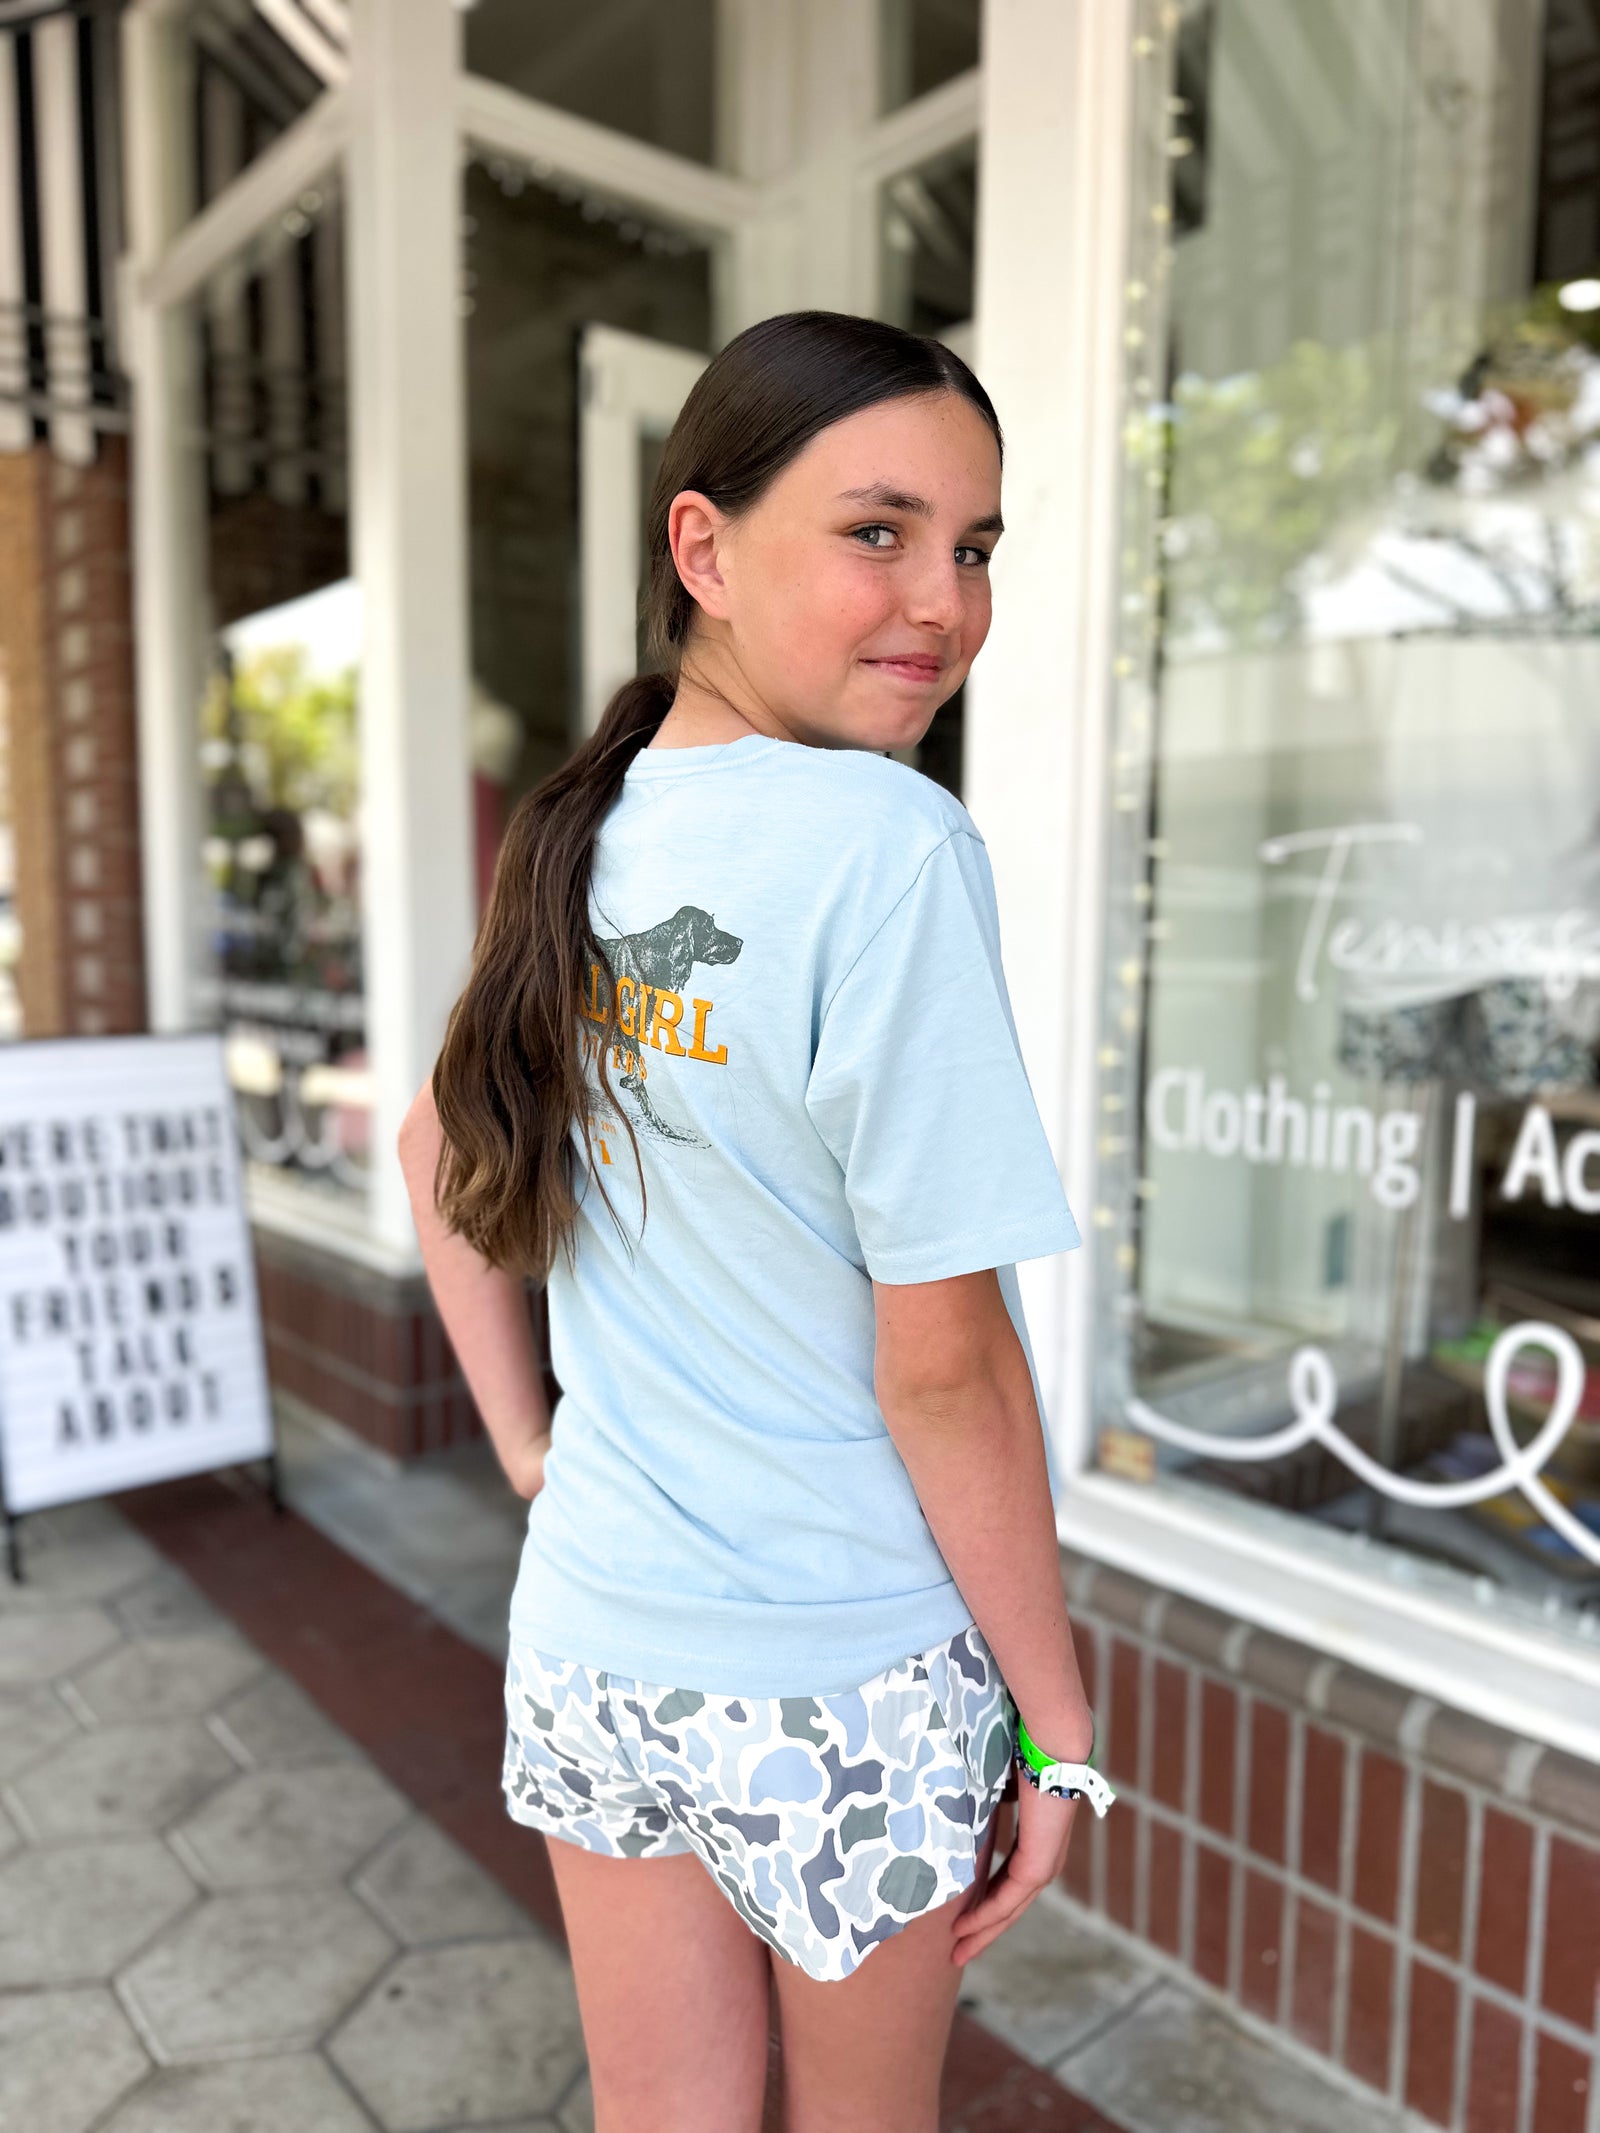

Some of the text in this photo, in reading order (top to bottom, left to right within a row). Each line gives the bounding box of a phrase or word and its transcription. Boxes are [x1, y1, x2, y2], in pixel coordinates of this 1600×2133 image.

[616, 976, 728, 1065] GIRL
[122, 1106, 222, 1156] THAT
[1146, 1067, 1420, 1208] Clothing
[62, 1220, 186, 1276] YOUR
[77, 1328, 194, 1385] TALK
[57, 1371, 222, 1445] ABOUT
